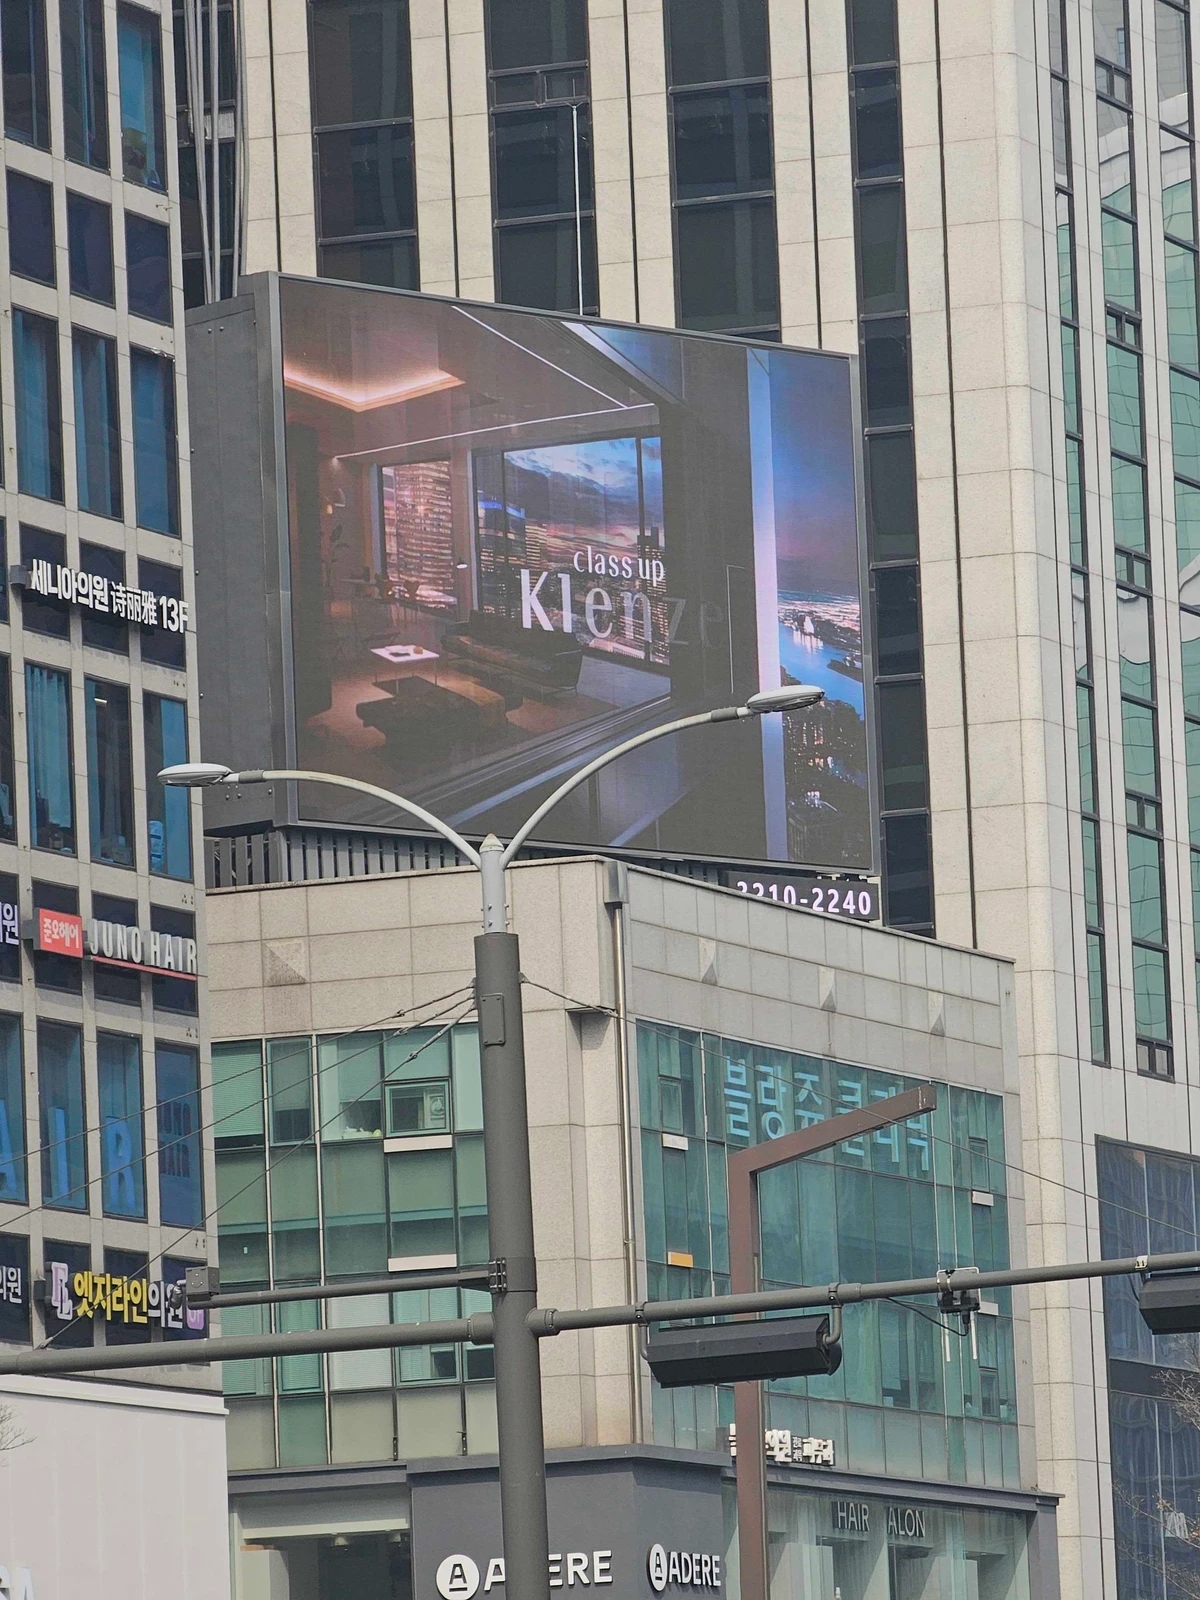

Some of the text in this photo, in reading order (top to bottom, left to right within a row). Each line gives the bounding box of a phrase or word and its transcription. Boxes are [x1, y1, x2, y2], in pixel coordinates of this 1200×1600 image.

[573, 545, 664, 587] class up
[31, 558, 109, 613] 세니아의원
[159, 595, 189, 634] 13F
[0, 902, 20, 946] 원
[43, 917, 80, 949] 준오헤어
[89, 917, 197, 974] JUNO HAIR
[837, 1501, 870, 1532] HAIR
[483, 1550, 614, 1591] AERE
[668, 1551, 721, 1587] ADERE
